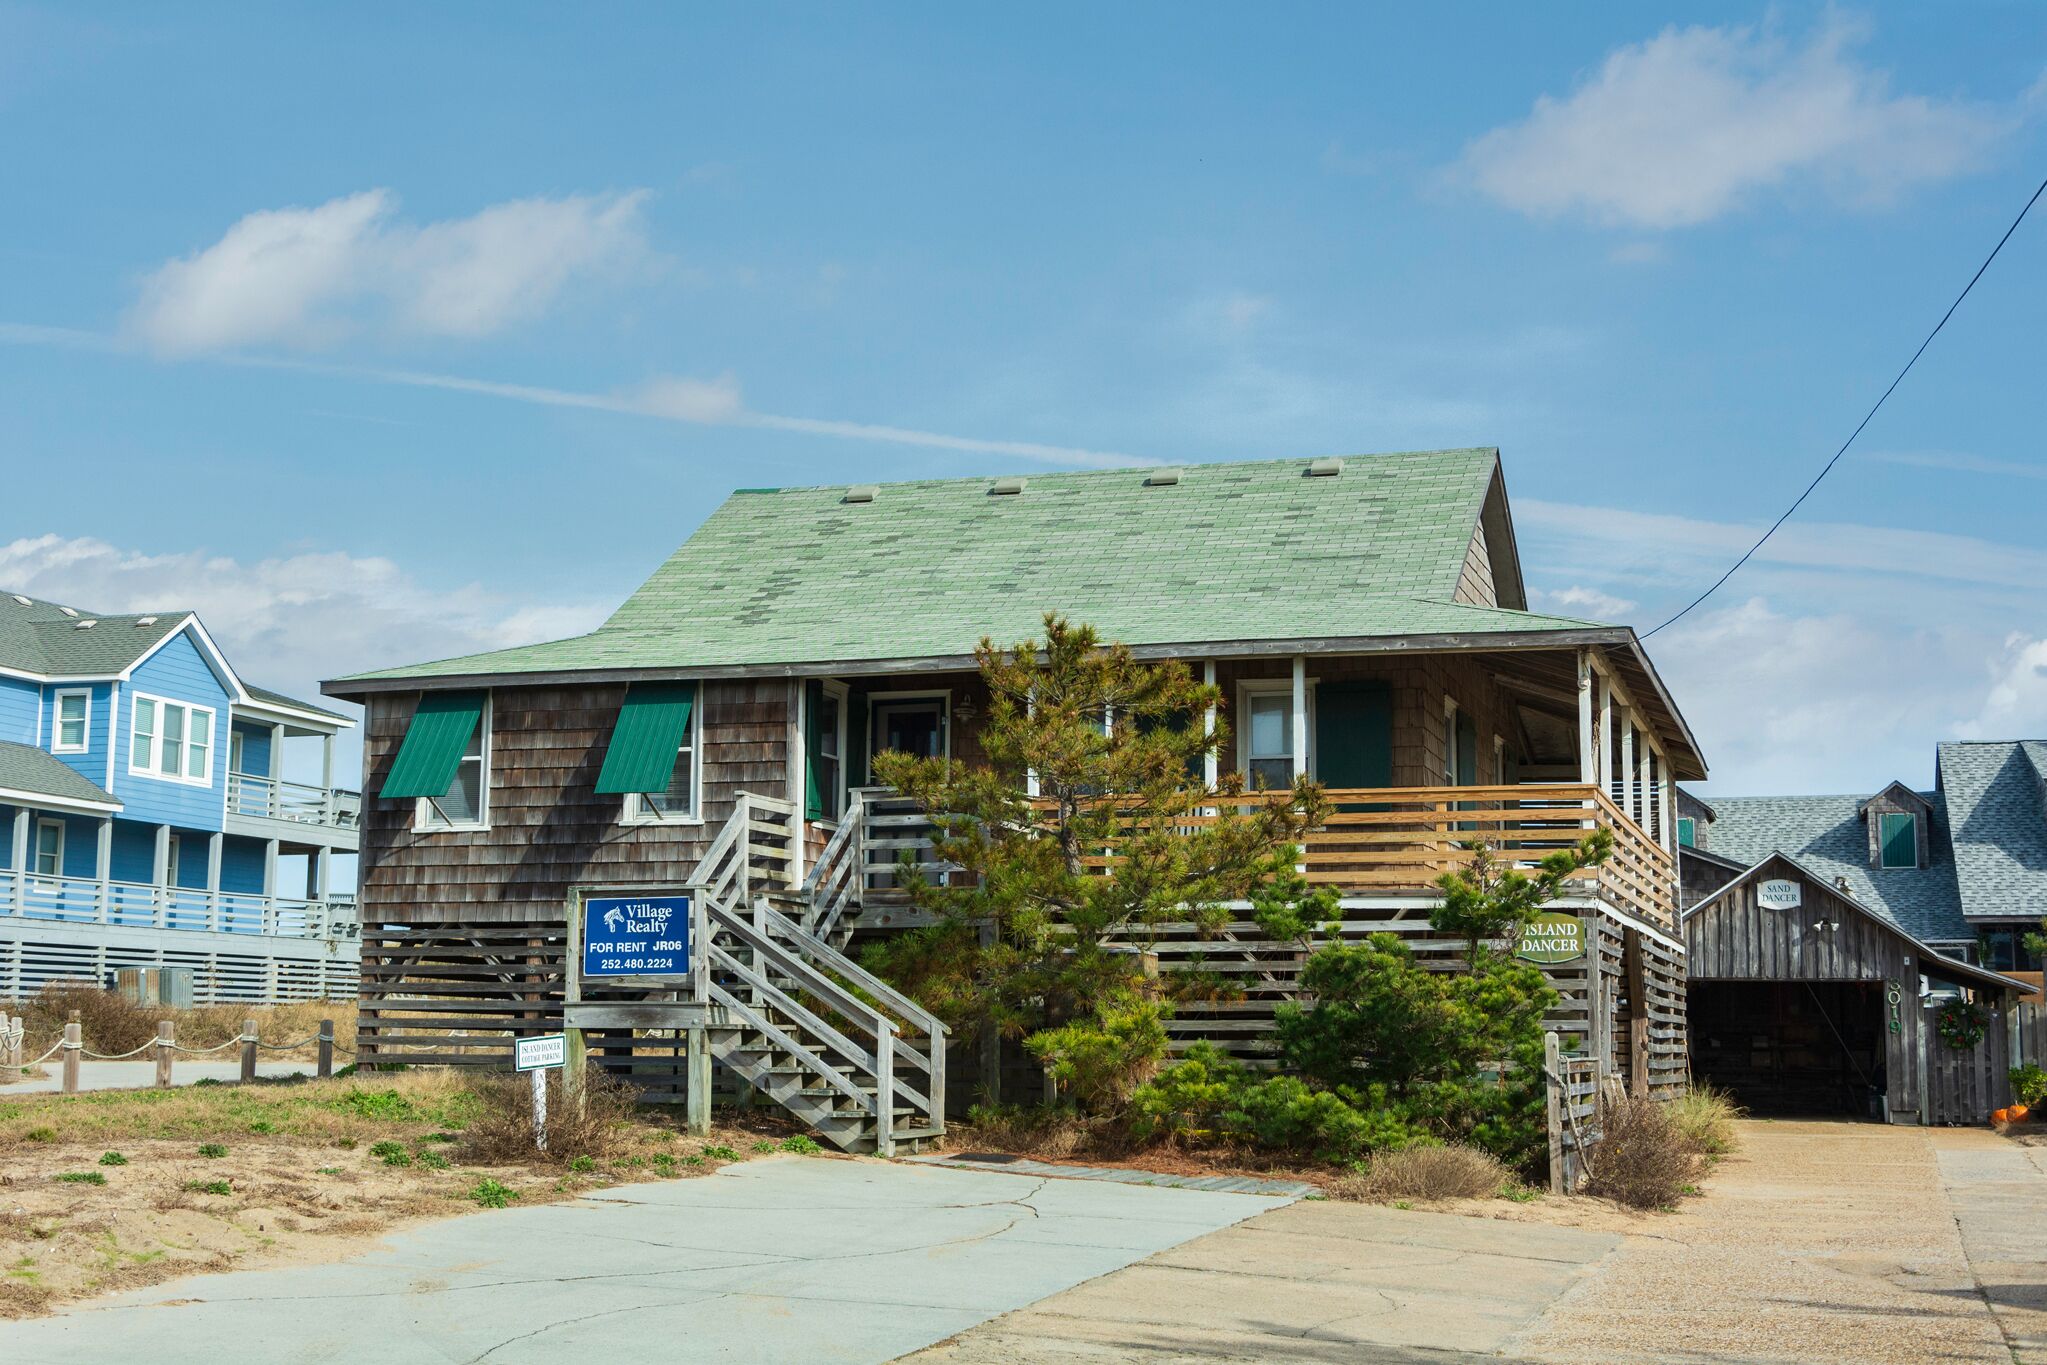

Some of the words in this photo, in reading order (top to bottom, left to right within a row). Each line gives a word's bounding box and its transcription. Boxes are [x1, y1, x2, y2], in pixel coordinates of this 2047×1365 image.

[626, 904, 673, 922] Village
[626, 919, 668, 936] Realty
[1525, 924, 1578, 936] ISLAND
[590, 943, 613, 953] FOR
[617, 942, 647, 952] RENT
[653, 941, 682, 951] JR06
[1522, 940, 1578, 952] DANCER
[602, 959, 673, 968] 252.480.2224
